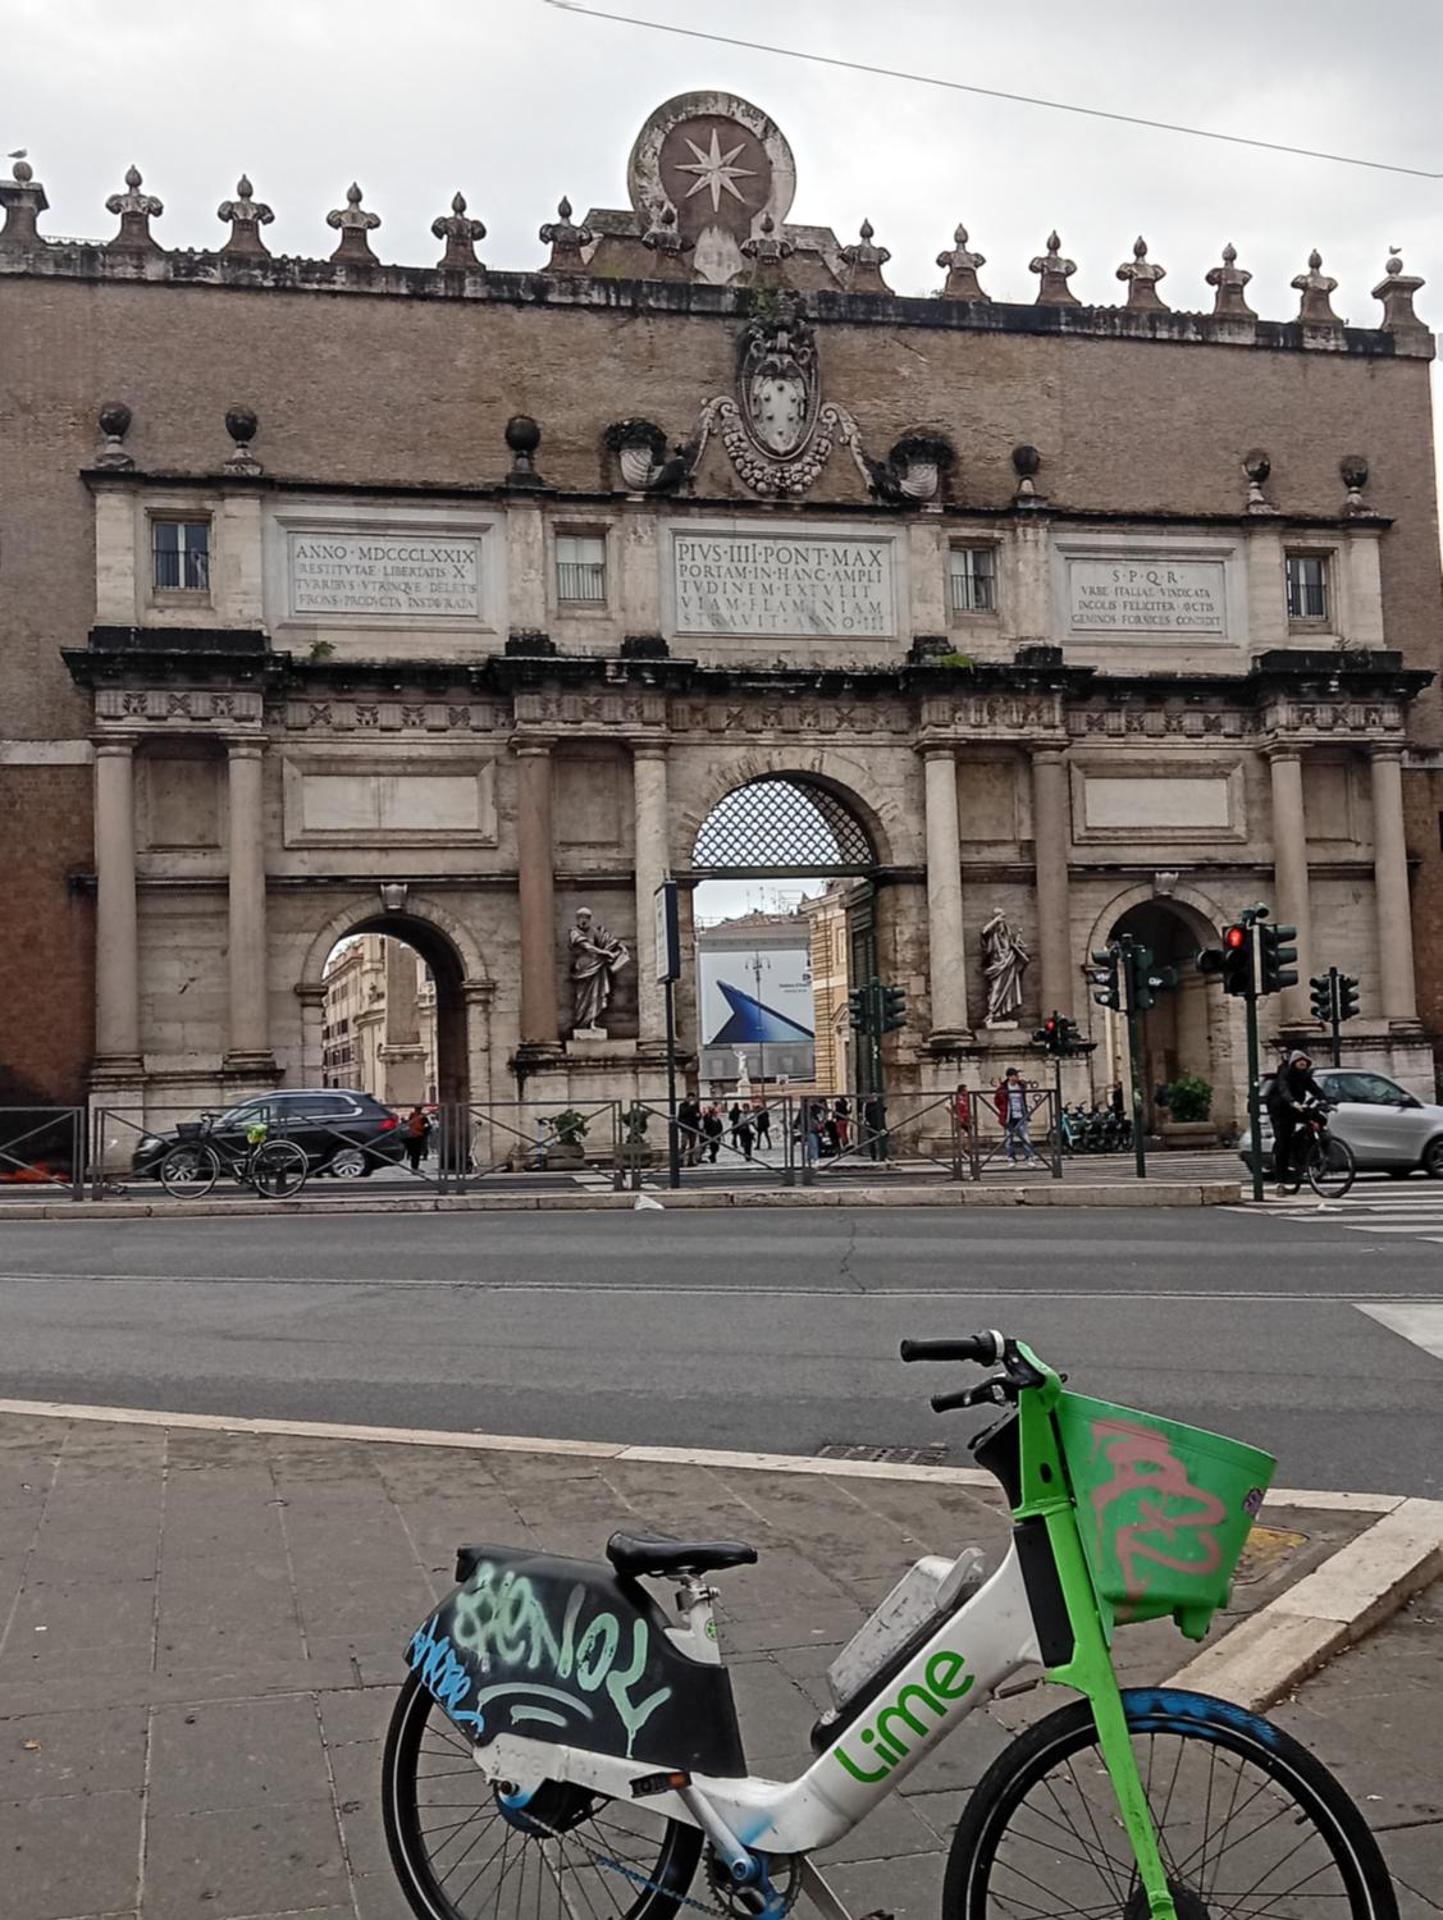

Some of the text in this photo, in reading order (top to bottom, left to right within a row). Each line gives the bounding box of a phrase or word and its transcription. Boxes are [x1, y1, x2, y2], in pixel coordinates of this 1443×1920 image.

[296, 545, 475, 564] ANNO MDCCCLXXIX
[831, 548, 883, 567] MAX
[832, 1650, 976, 1783] Lime
